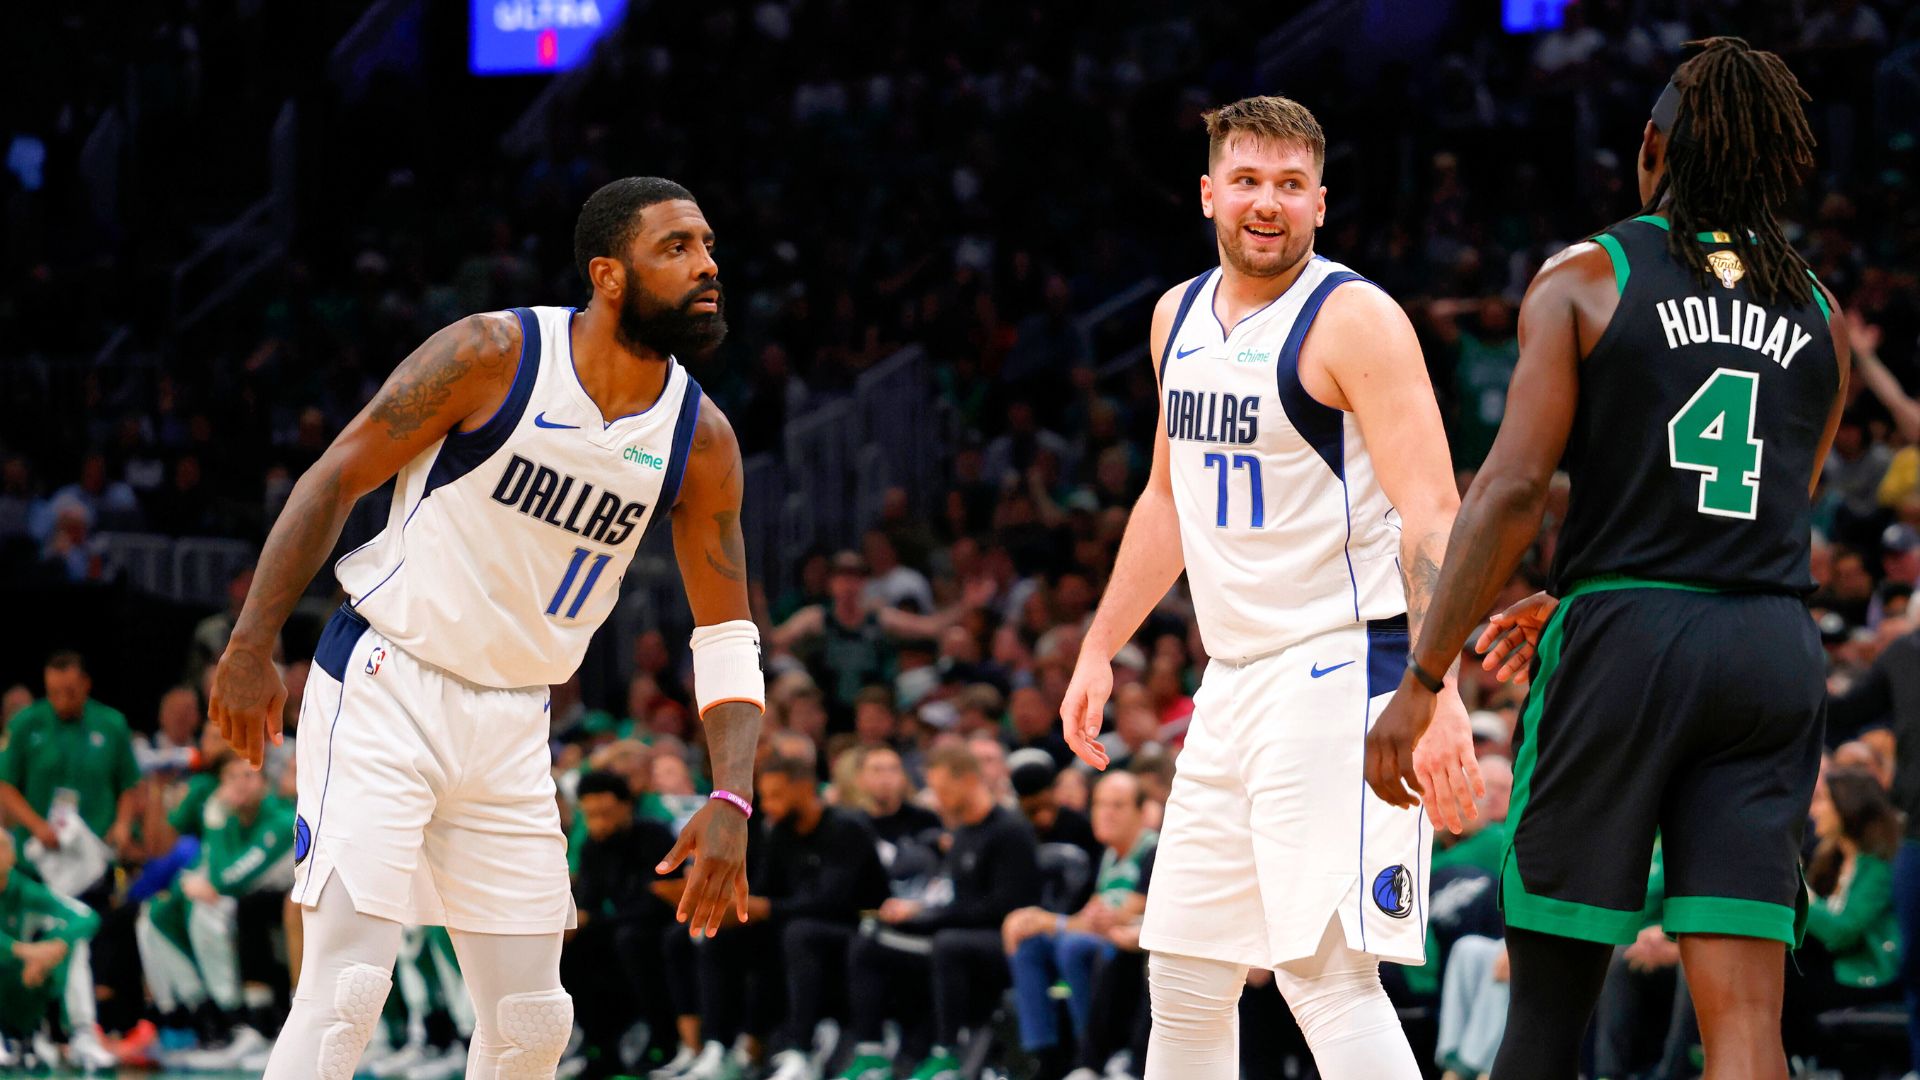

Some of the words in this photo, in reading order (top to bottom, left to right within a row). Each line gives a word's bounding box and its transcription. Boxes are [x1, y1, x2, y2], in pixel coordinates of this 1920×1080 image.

[1709, 255, 1743, 271] Finals
[1237, 348, 1270, 362] chime
[1656, 296, 1812, 370] HOLIDAY
[1167, 388, 1262, 445] DALLAS
[1668, 367, 1763, 520] 4
[623, 444, 663, 470] chime
[1203, 451, 1265, 529] 77
[489, 452, 648, 546] DALLAS
[544, 545, 614, 620] 11
